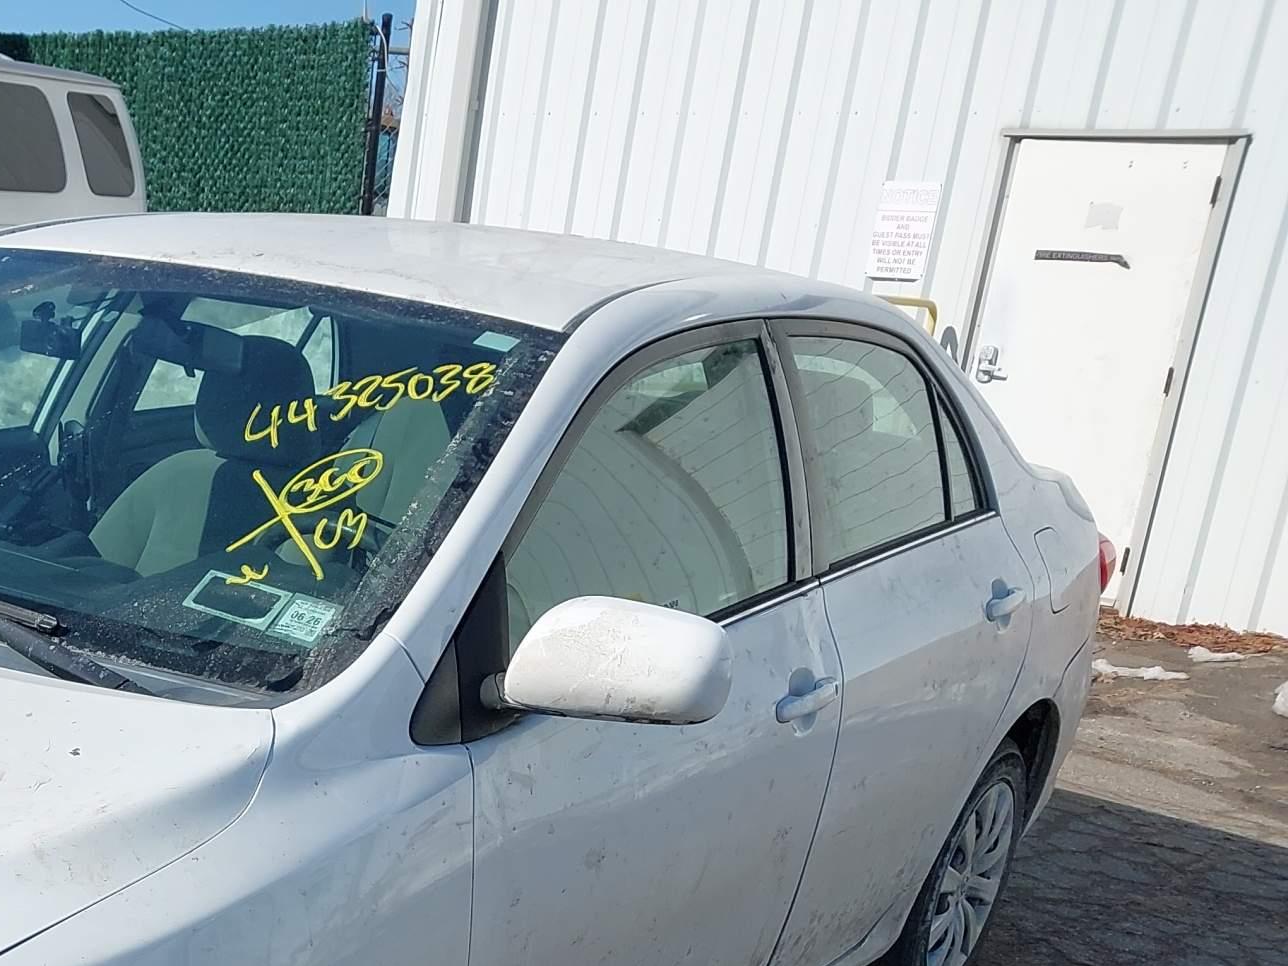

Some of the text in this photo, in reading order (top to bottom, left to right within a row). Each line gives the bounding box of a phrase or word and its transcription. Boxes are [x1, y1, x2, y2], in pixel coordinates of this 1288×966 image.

[879, 188, 937, 206] NOTICE
[905, 215, 928, 223] BADGE
[902, 249, 923, 257] ENTRY
[892, 257, 905, 265] NOT
[876, 266, 912, 274] PERMITTED
